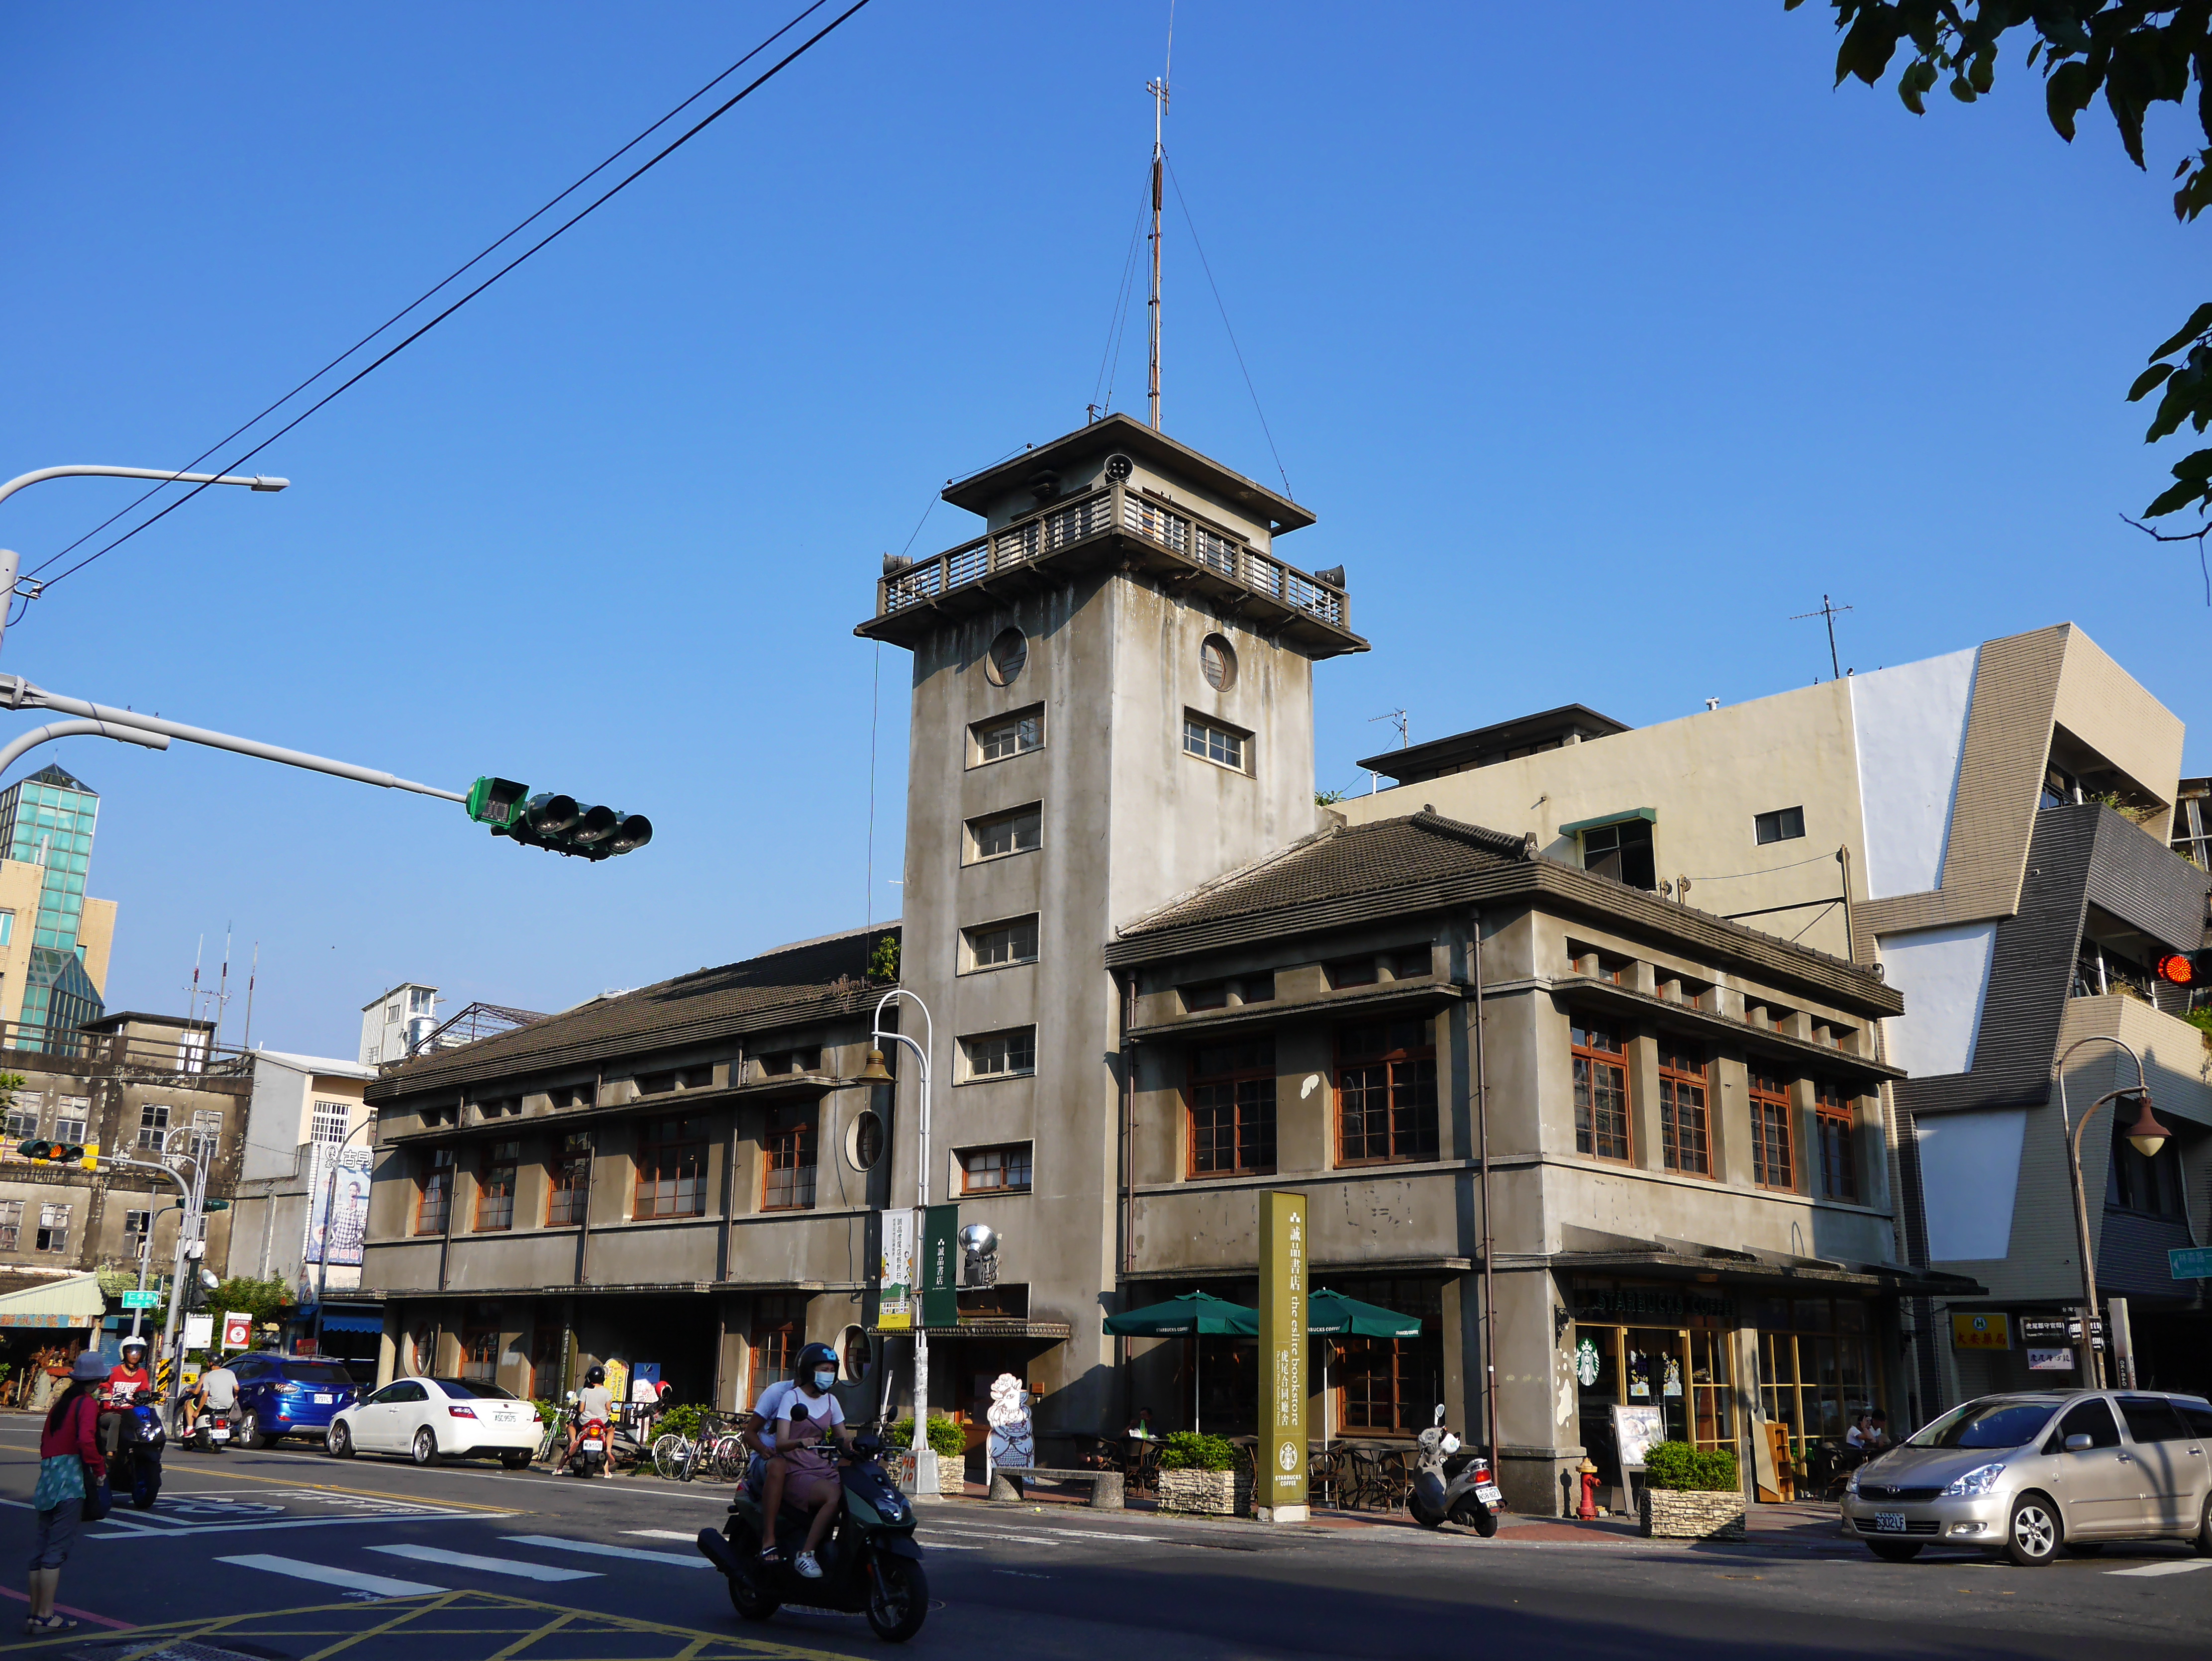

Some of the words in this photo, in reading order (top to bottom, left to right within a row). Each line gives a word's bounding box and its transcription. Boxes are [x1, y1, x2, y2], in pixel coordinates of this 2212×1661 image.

[1290, 1226, 1301, 1290] 誠品書店
[1597, 1290, 1684, 1314] STARBUCKS
[1692, 1295, 1736, 1317] COFFEE
[1292, 1319, 1300, 1355] eslite
[1292, 1358, 1300, 1426] bookstore
[903, 1455, 915, 1469] HB
[903, 1472, 913, 1482] 10
